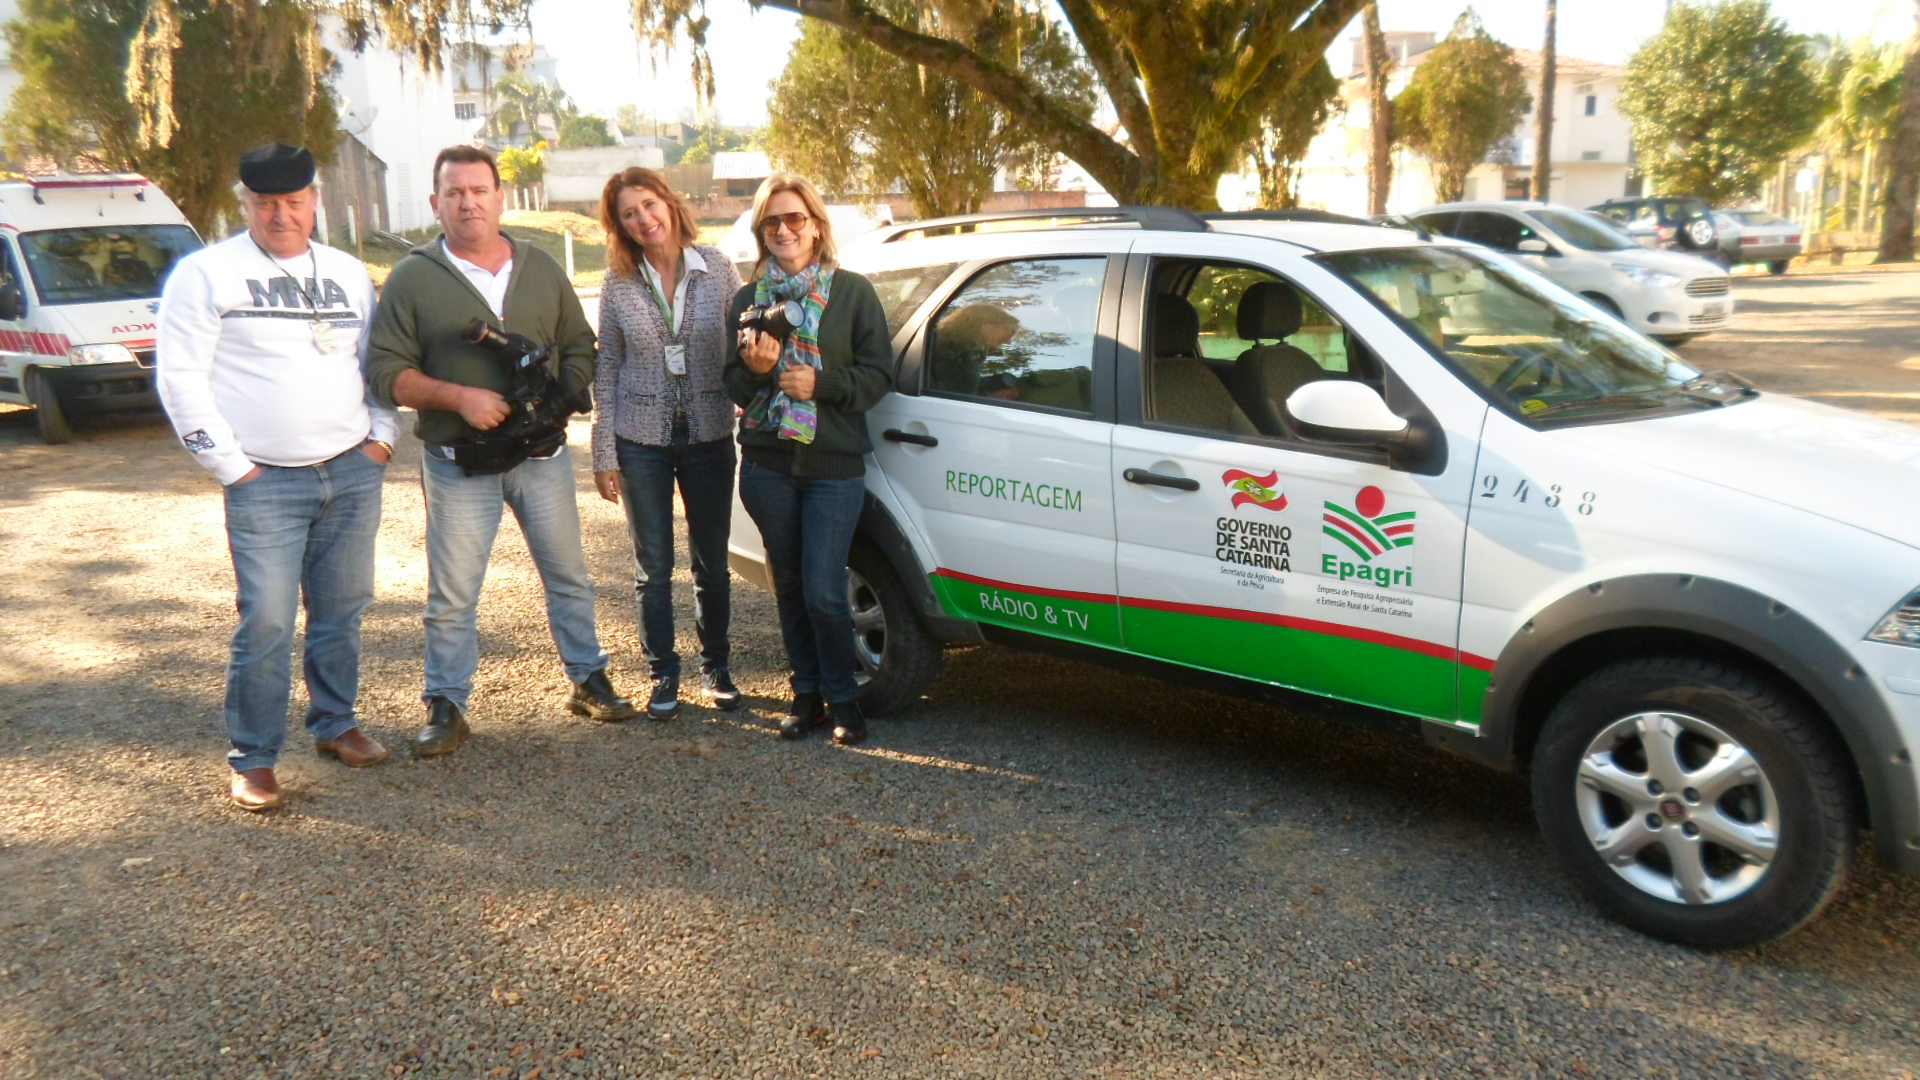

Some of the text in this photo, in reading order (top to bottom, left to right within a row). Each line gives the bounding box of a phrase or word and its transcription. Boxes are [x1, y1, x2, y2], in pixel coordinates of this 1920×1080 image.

[246, 277, 350, 309] MMA
[946, 470, 1082, 512] REPORTAGEM
[1481, 475, 1596, 516] 2438
[1216, 517, 1292, 541] GOVERNO
[1216, 532, 1291, 557] DE SANTA
[1216, 548, 1292, 573] CATARINA
[1321, 554, 1413, 587] Epagri
[1220, 566, 1285, 584] Secretaria da Agricultura
[1241, 579, 1249, 587] da
[1249, 580, 1265, 590] Pesca
[1317, 584, 1414, 606] Empresa de Pesquisa Agropecuária
[1321, 596, 1346, 608] Extensão
[1347, 600, 1361, 610] Rural
[1362, 603, 1370, 611] de
[1370, 604, 1388, 614] Santa
[1388, 607, 1413, 618] Catarina
[979, 591, 1088, 631] RÁDIO & TV
